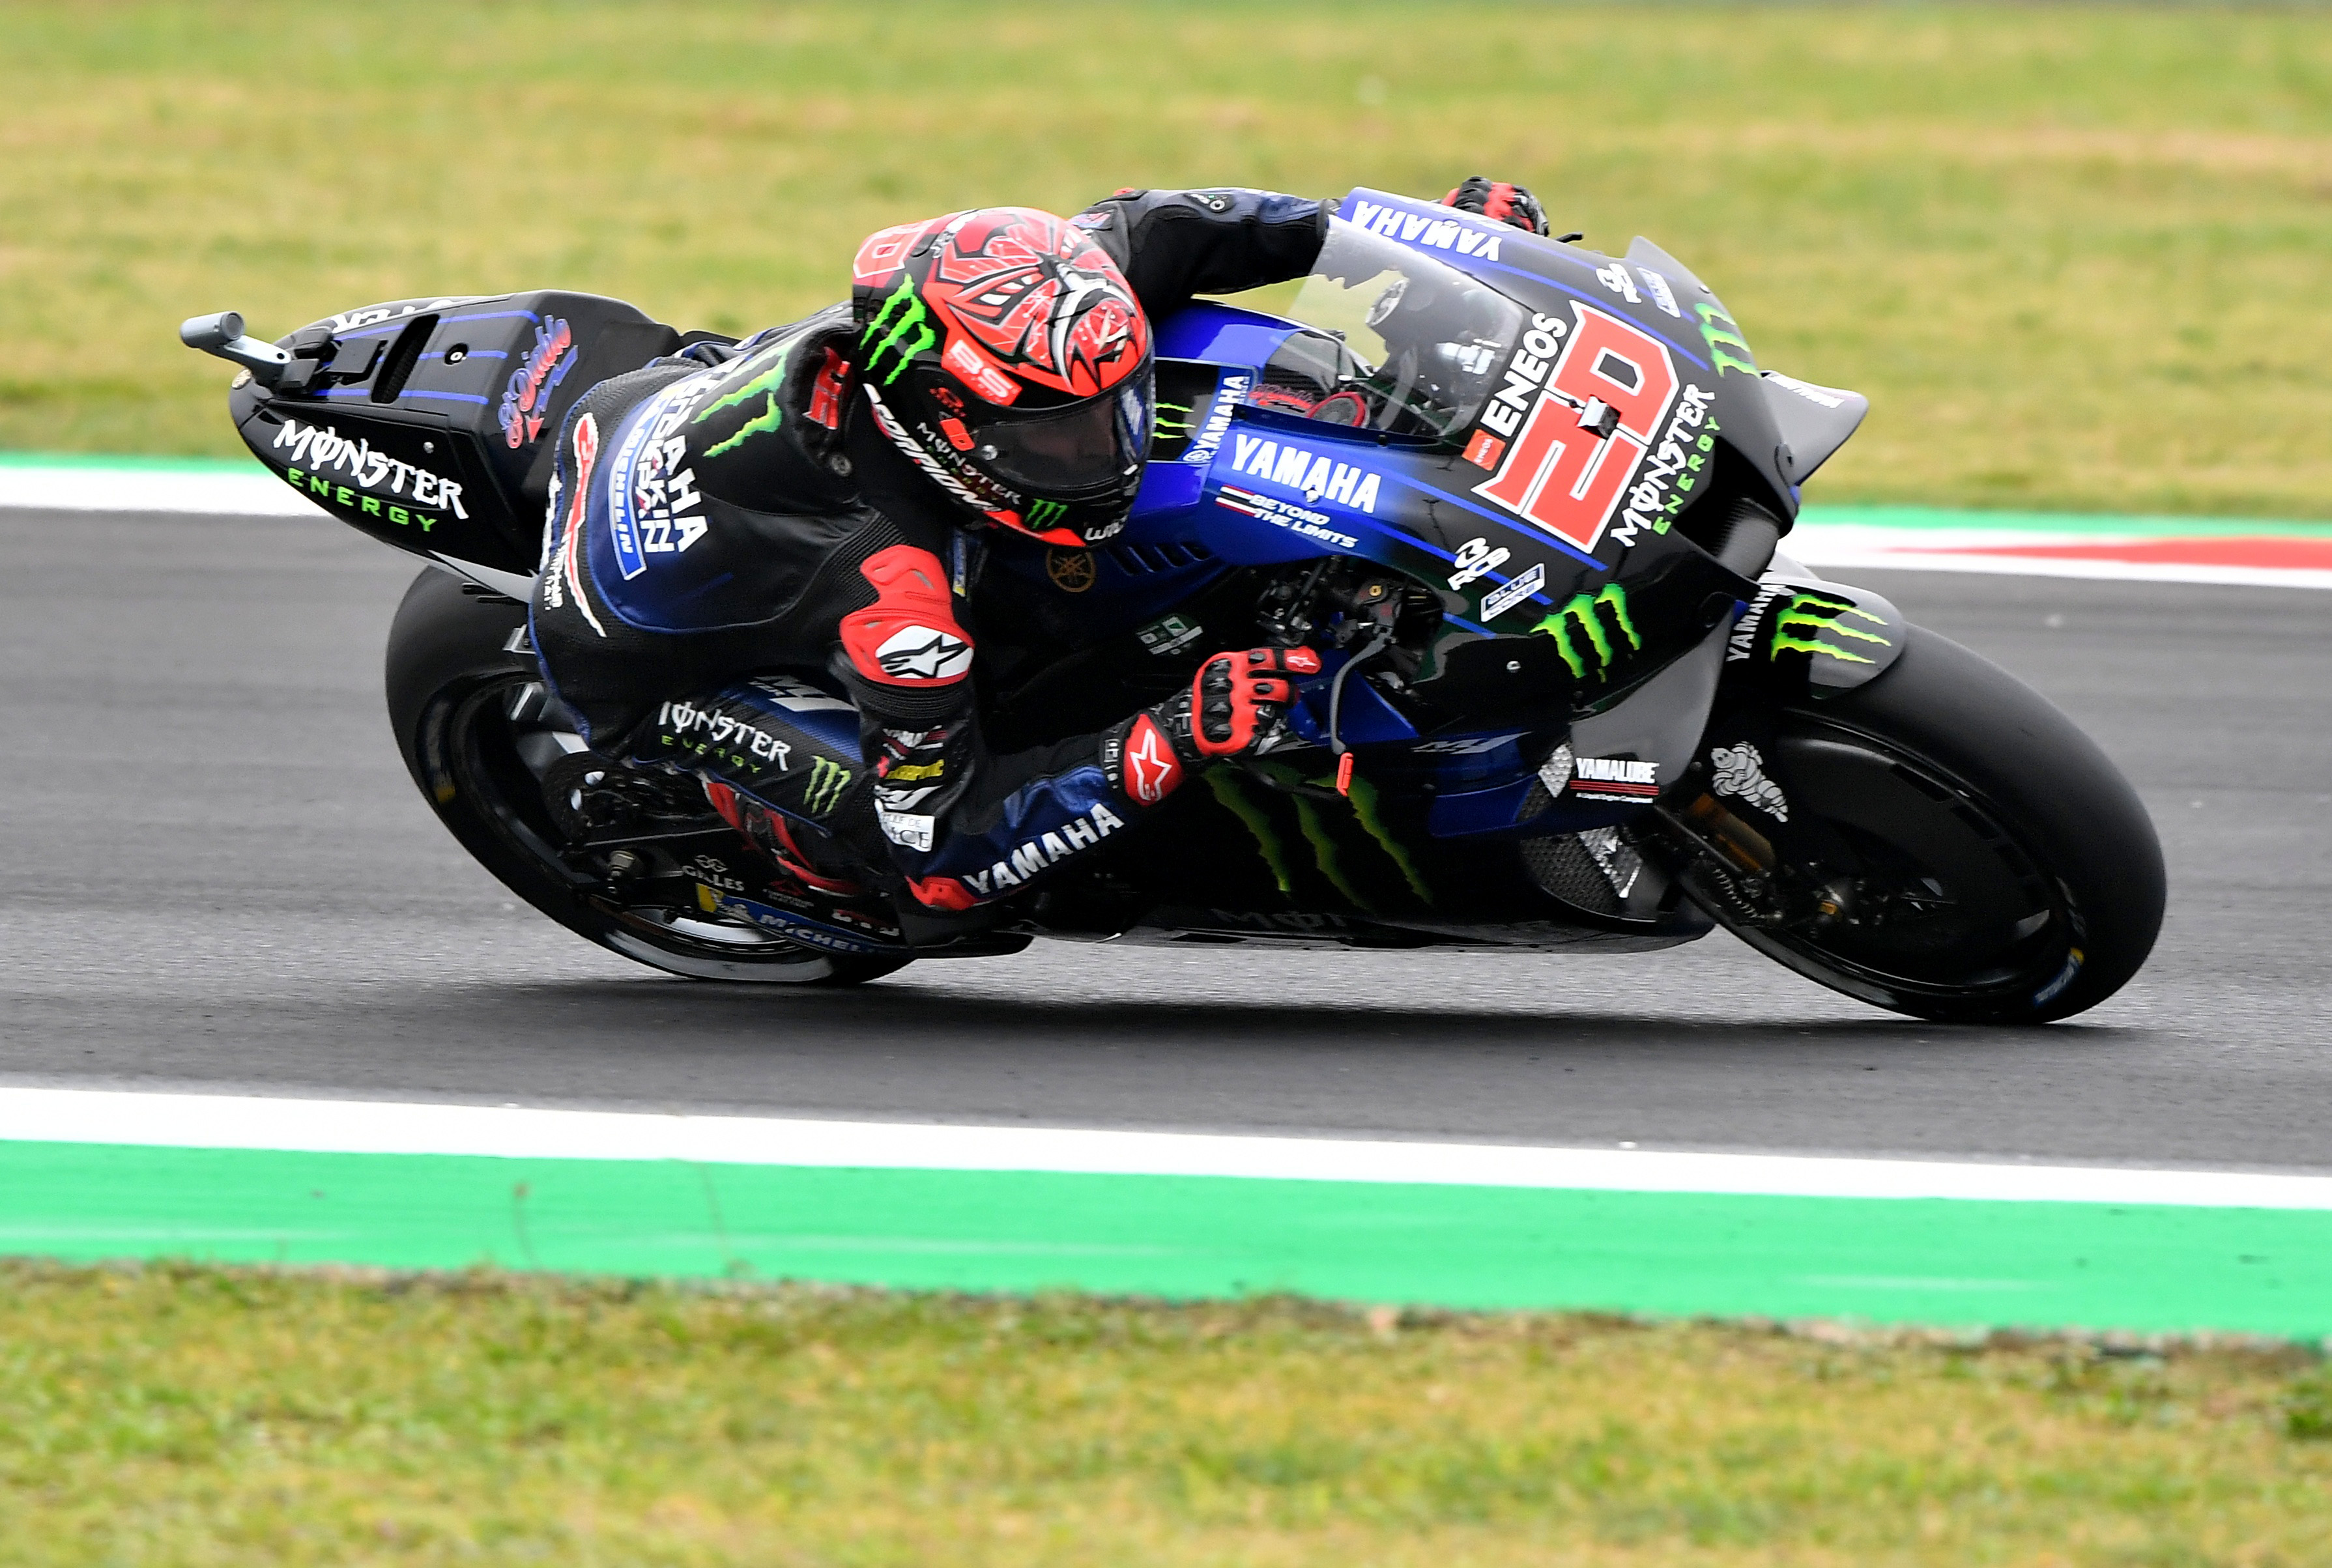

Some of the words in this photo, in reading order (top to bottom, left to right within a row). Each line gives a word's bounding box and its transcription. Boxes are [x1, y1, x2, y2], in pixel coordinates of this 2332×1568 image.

[1350, 200, 1503, 262] YAMAHA
[949, 339, 1014, 398] BS
[1480, 313, 1567, 437] ENEOS
[1193, 376, 1245, 450] YAMAHA
[1471, 299, 1680, 554] 20
[273, 420, 469, 520] MONSTER
[287, 468, 437, 532] ENERGY
[1231, 433, 1381, 513] YAMAHA
[1610, 384, 1715, 546] MONSTER
[1652, 416, 1721, 535] ENERGY
[1250, 494, 1331, 525] BEYOND
[1254, 509, 1291, 525] THE
[1292, 520, 1358, 548] LIMITS
[1447, 547, 1511, 591] RCB
[962, 803, 1125, 895] YAMAHA
